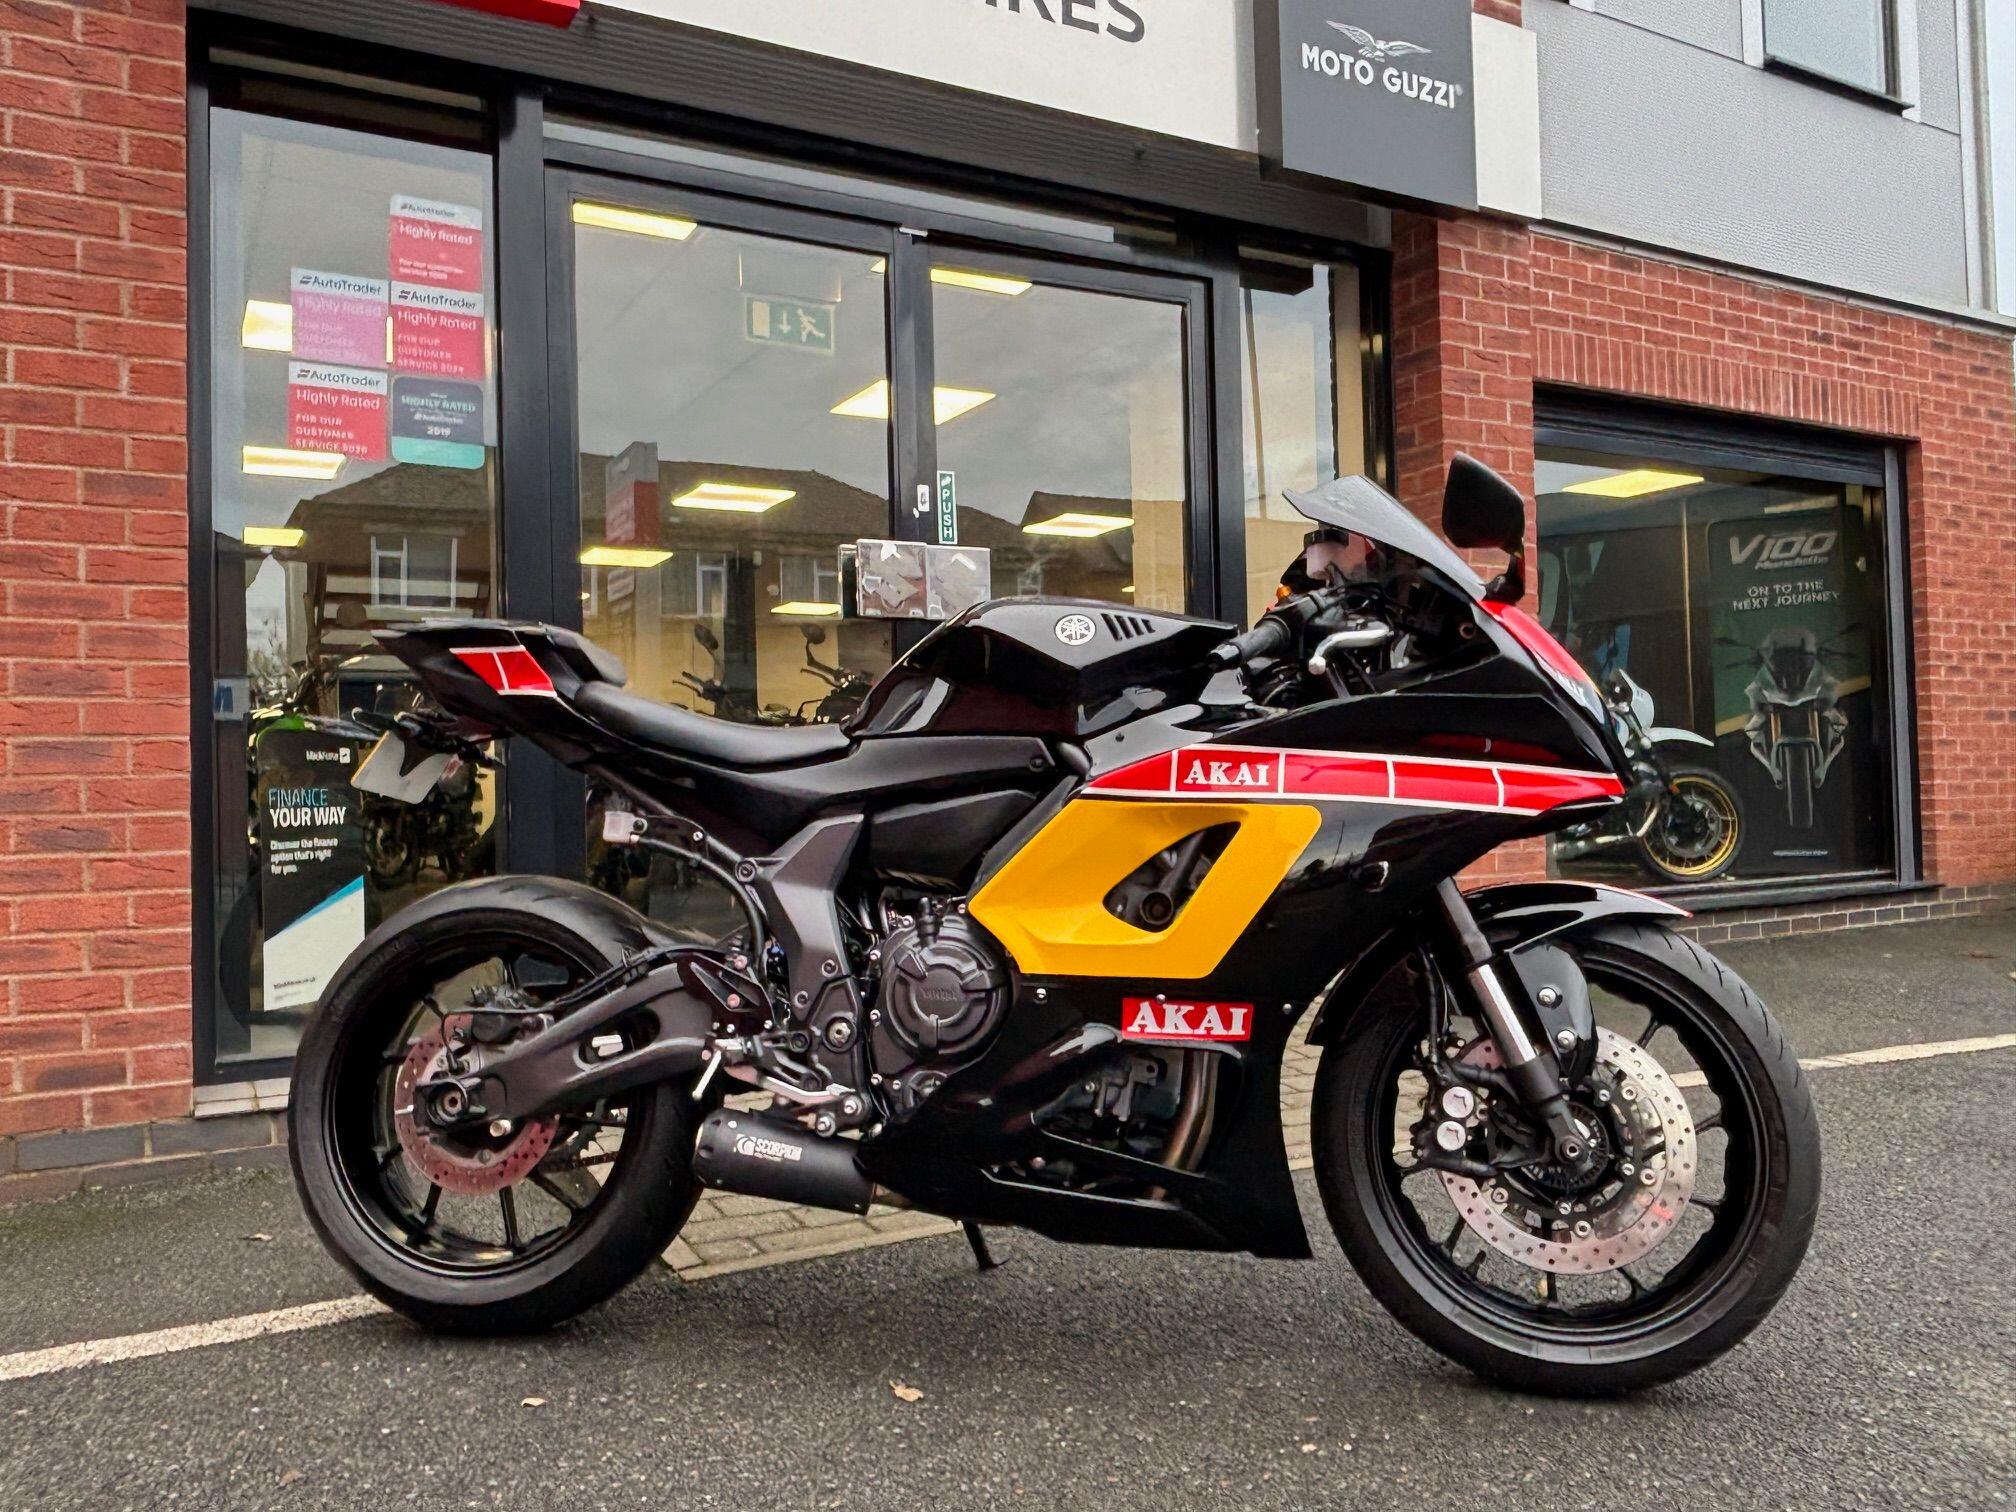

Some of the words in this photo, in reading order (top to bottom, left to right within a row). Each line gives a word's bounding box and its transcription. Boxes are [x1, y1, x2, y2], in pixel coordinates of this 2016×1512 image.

[1302, 42, 1374, 86] MOTO
[1382, 66, 1455, 109] GUZZI
[400, 223, 436, 241] Highly
[438, 230, 473, 245] Rated
[312, 275, 382, 295] AutoTrader
[411, 290, 476, 310] AutoTrader
[398, 311, 438, 328] Highly
[440, 315, 477, 331] Rated
[311, 370, 381, 388] AutoTrader
[296, 389, 339, 407] Highly
[341, 394, 380, 410] Rated
[320, 416, 342, 426] OUR
[942, 488, 953, 539] PUSH
[1729, 530, 1838, 565] V100
[1748, 585, 1769, 598] ON
[1773, 583, 1792, 595] TO
[1797, 579, 1824, 592] THE
[1733, 597, 1769, 611] NEXT
[1774, 591, 1839, 608] JOURNEY
[1183, 759, 1270, 786] AKAI
[268, 787, 329, 808] FINANCE
[269, 806, 311, 829] YOUR
[313, 806, 347, 827] WAY
[1126, 1000, 1249, 1036] AKAI
